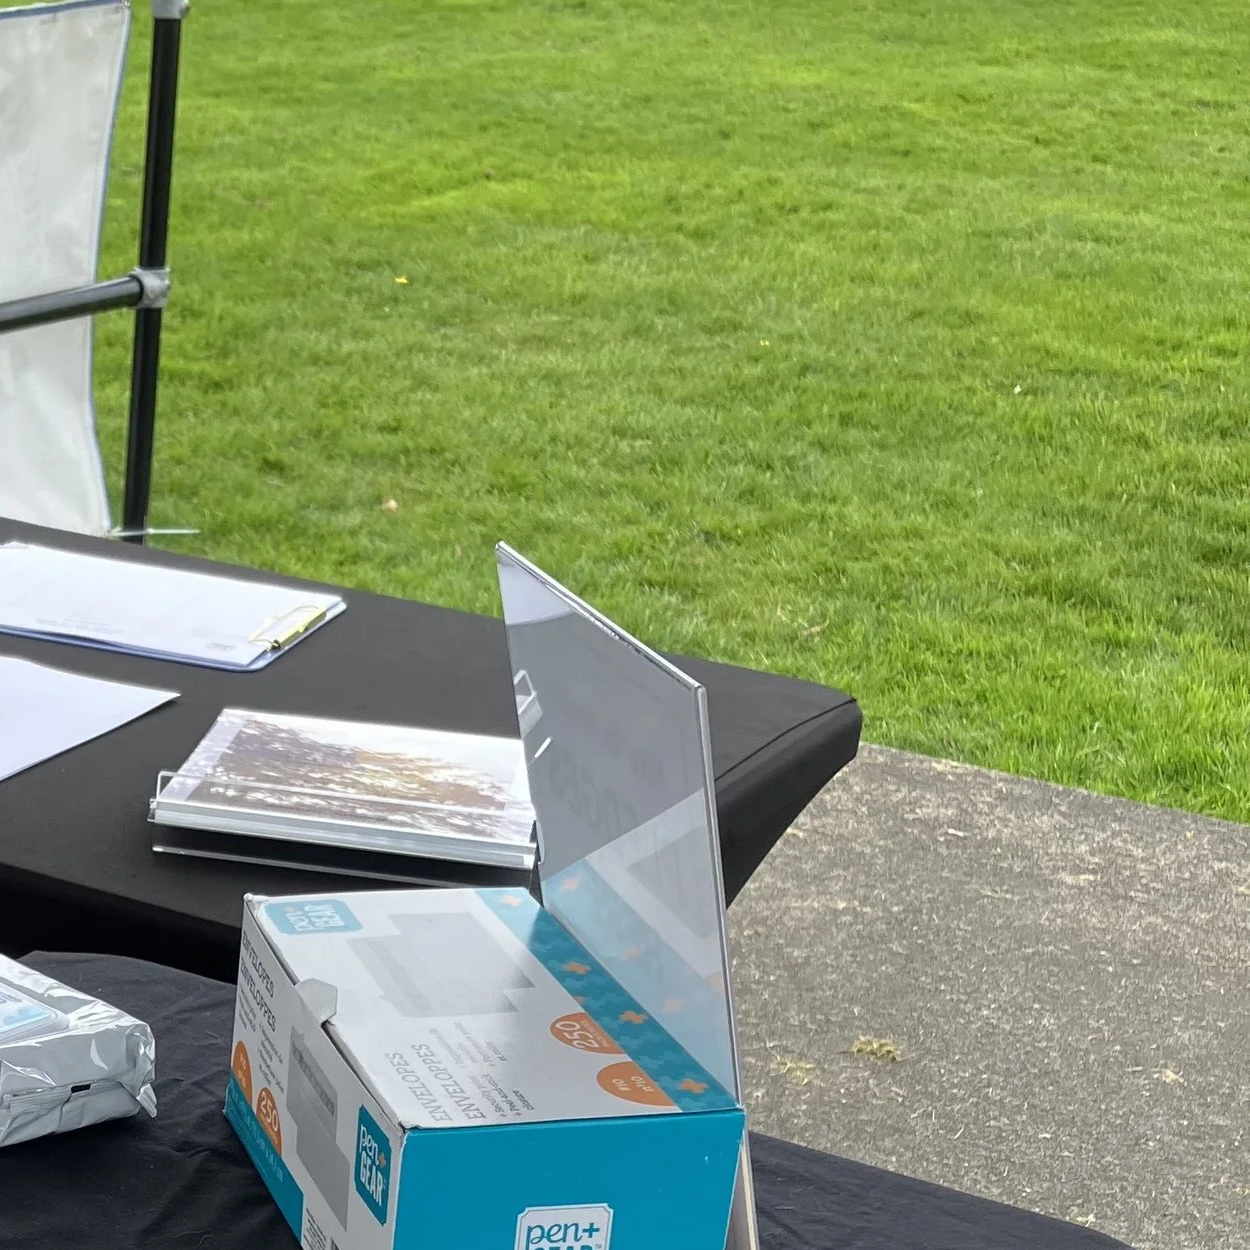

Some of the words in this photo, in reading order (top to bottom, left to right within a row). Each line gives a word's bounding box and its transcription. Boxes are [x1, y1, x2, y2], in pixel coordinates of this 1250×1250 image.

[240, 958, 277, 1033] ENVELOPPES
[242, 930, 275, 999] ENVELOPES
[555, 1020, 600, 1049] 250
[261, 1094, 279, 1133] 250
[385, 1052, 453, 1122] ENVELOPES
[411, 1043, 487, 1121] ENVELOPPES
[360, 1153, 383, 1207] GEAR
